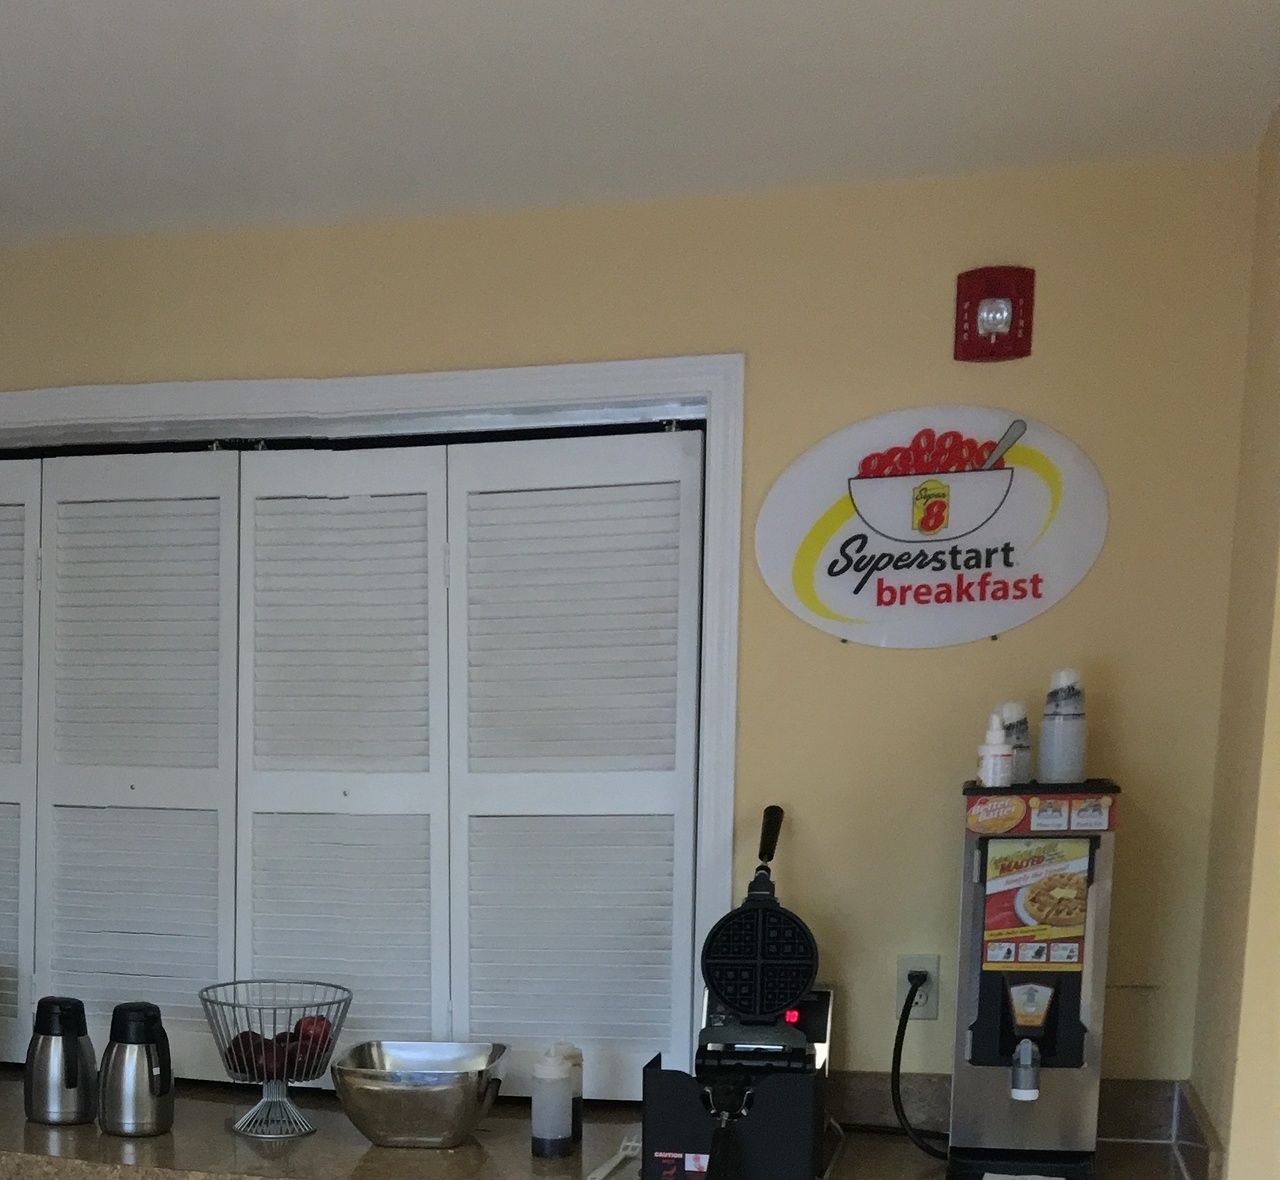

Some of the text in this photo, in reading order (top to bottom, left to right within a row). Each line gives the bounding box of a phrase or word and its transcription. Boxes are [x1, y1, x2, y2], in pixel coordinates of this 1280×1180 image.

[919, 498, 948, 533] 8
[827, 534, 1015, 594] Superstart
[876, 571, 1043, 607] breakfast
